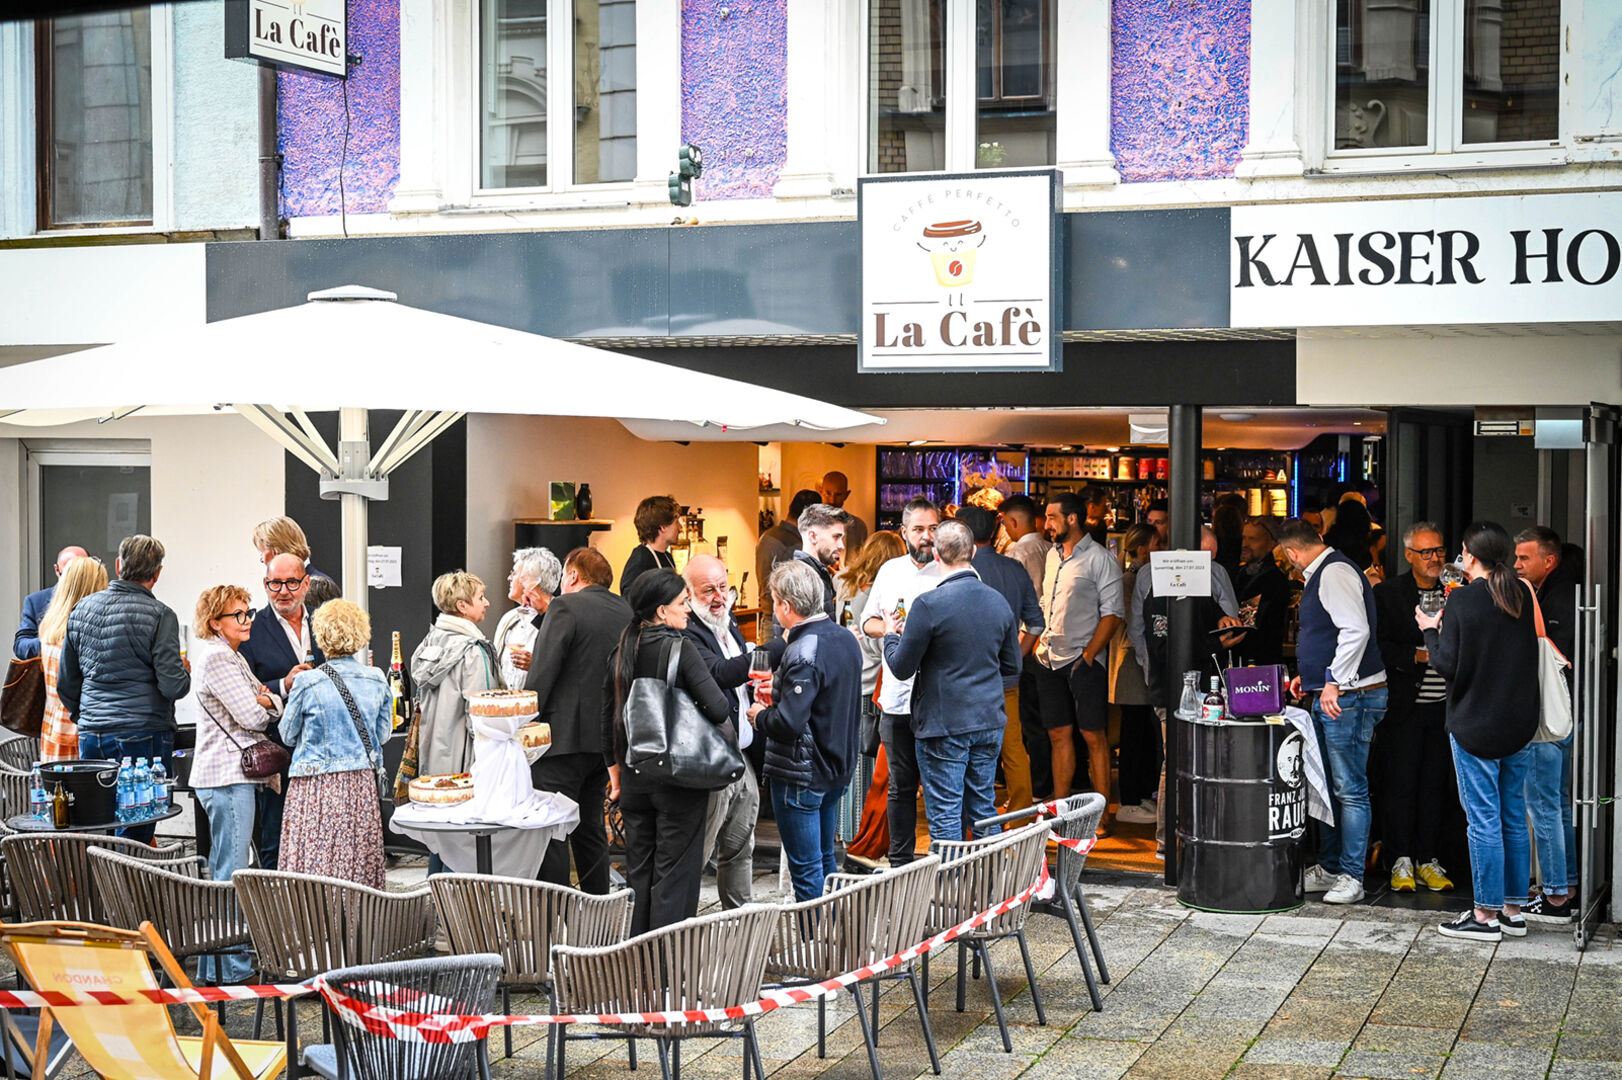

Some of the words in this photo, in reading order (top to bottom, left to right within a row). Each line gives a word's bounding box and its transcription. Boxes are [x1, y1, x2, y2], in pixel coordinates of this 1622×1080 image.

[254, 8, 282, 44] La
[290, 19, 341, 58] Cafè
[945, 189, 1020, 228] PERFETTO
[1234, 230, 1486, 288] KAISER
[1510, 228, 1621, 286] HO
[873, 313, 926, 348] La
[940, 307, 1042, 347] Cafè
[1235, 681, 1270, 694] MONIN
[1268, 790, 1297, 806] FRANZ
